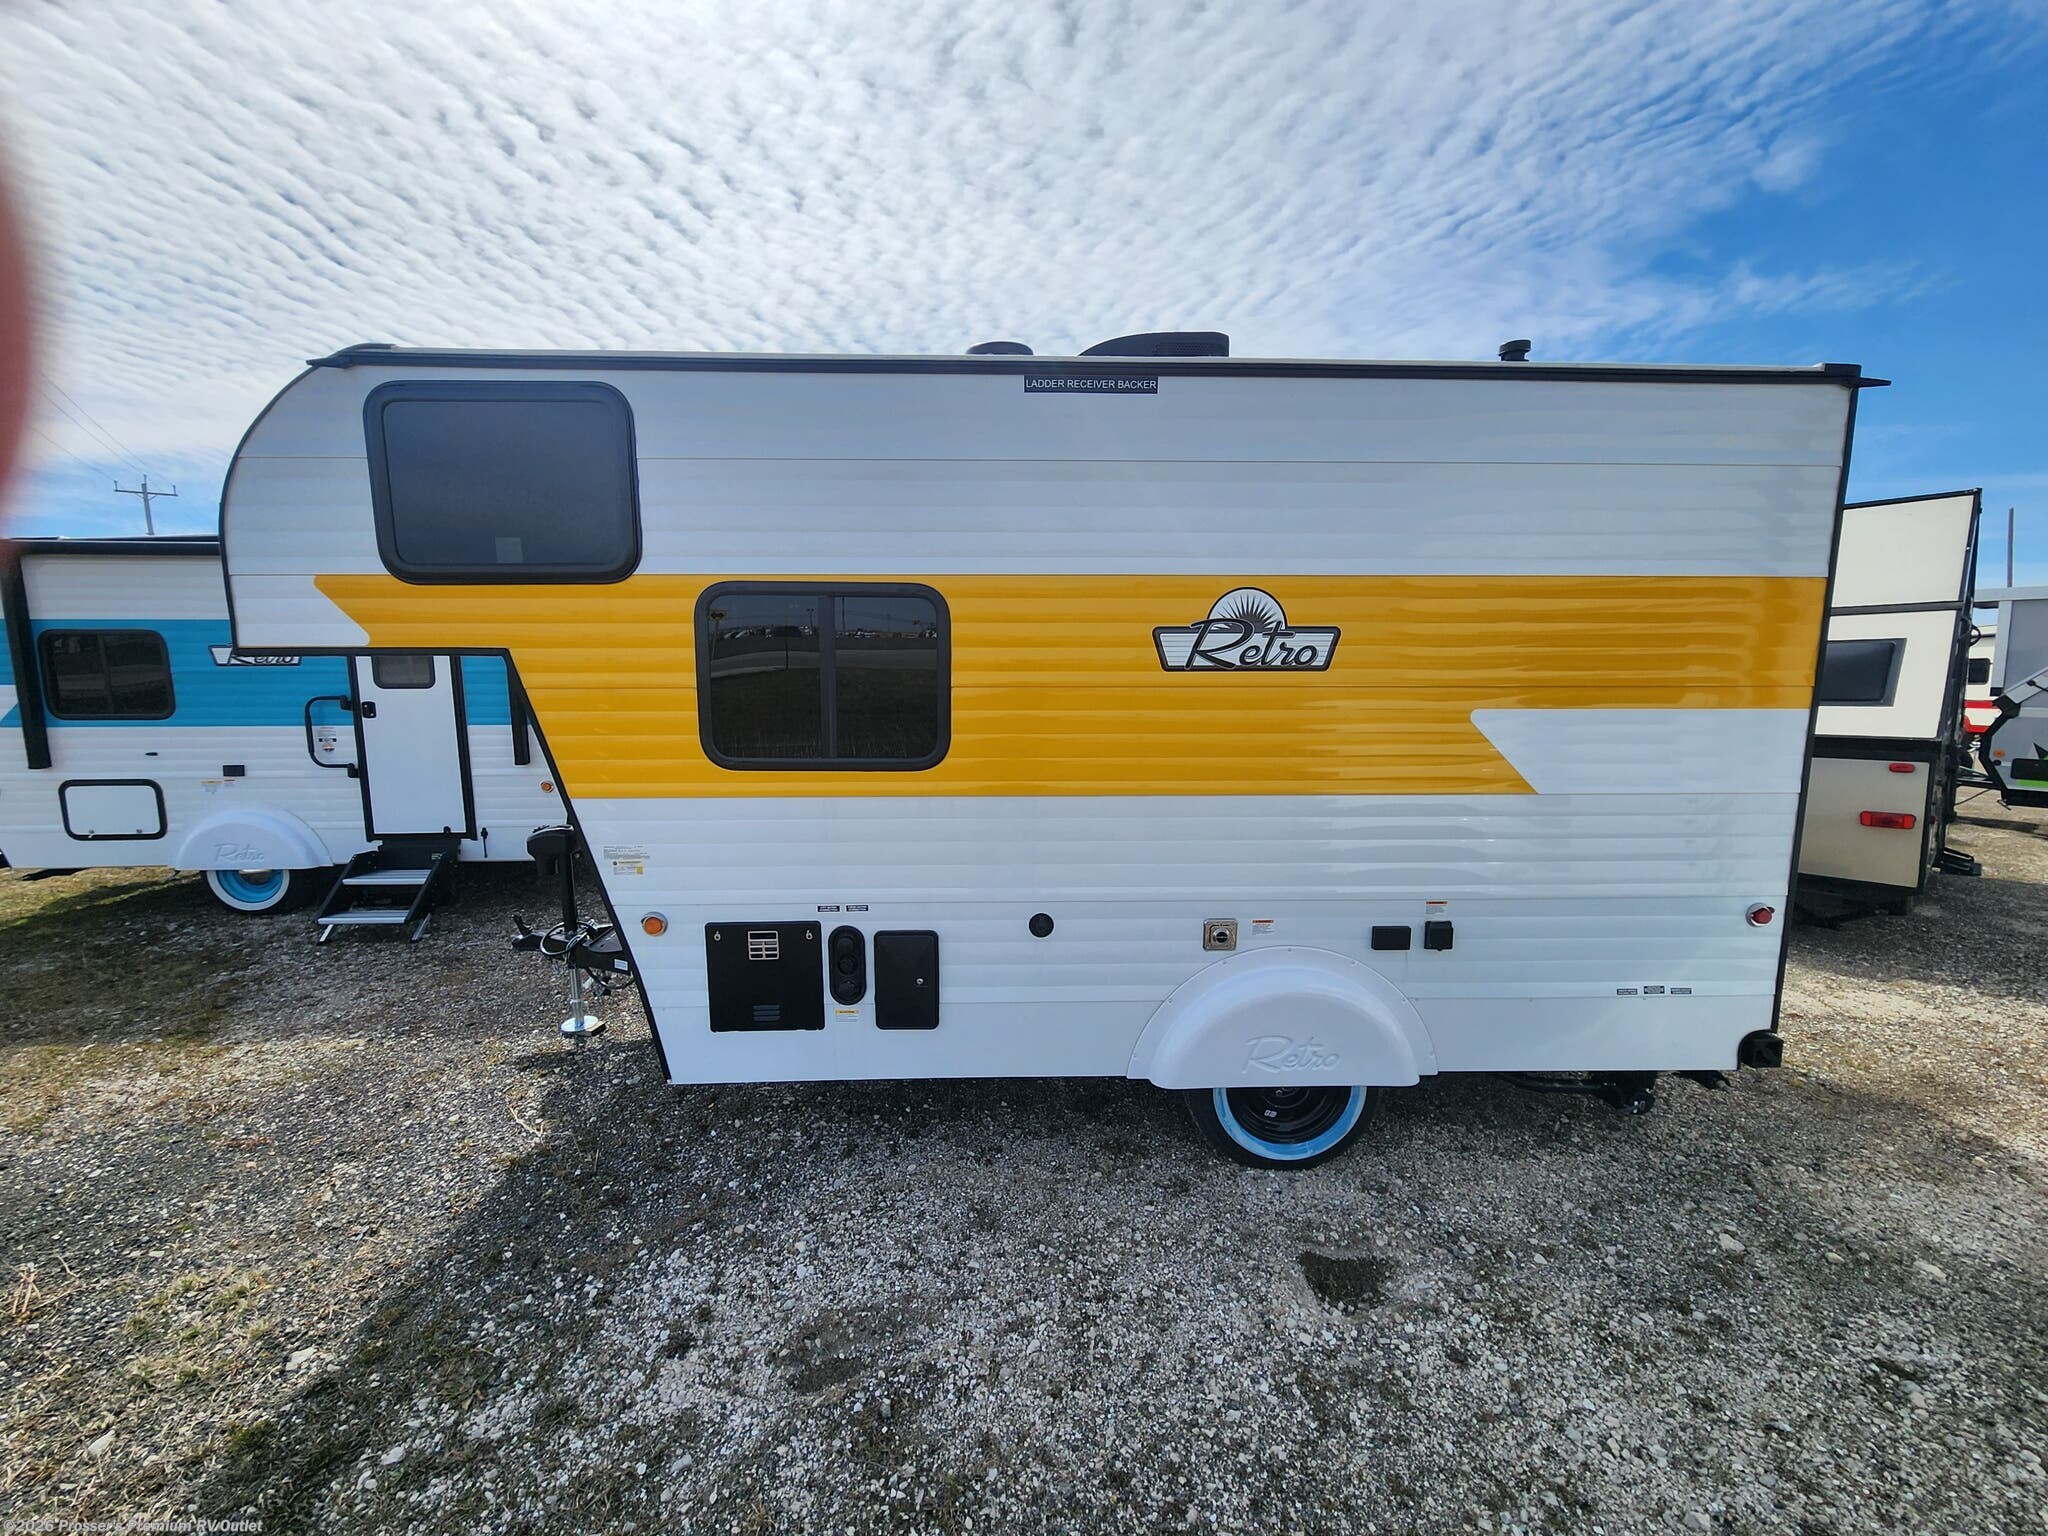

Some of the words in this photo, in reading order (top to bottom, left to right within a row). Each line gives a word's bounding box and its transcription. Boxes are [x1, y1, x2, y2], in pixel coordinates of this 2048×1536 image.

[1025, 379, 1065, 388] LADDER
[1066, 379, 1116, 389] RECEIVER
[1117, 380, 1157, 389] BACKER
[1185, 618, 1318, 670] Retro
[213, 842, 265, 863] Retro
[1240, 1035, 1340, 1074] Retro
